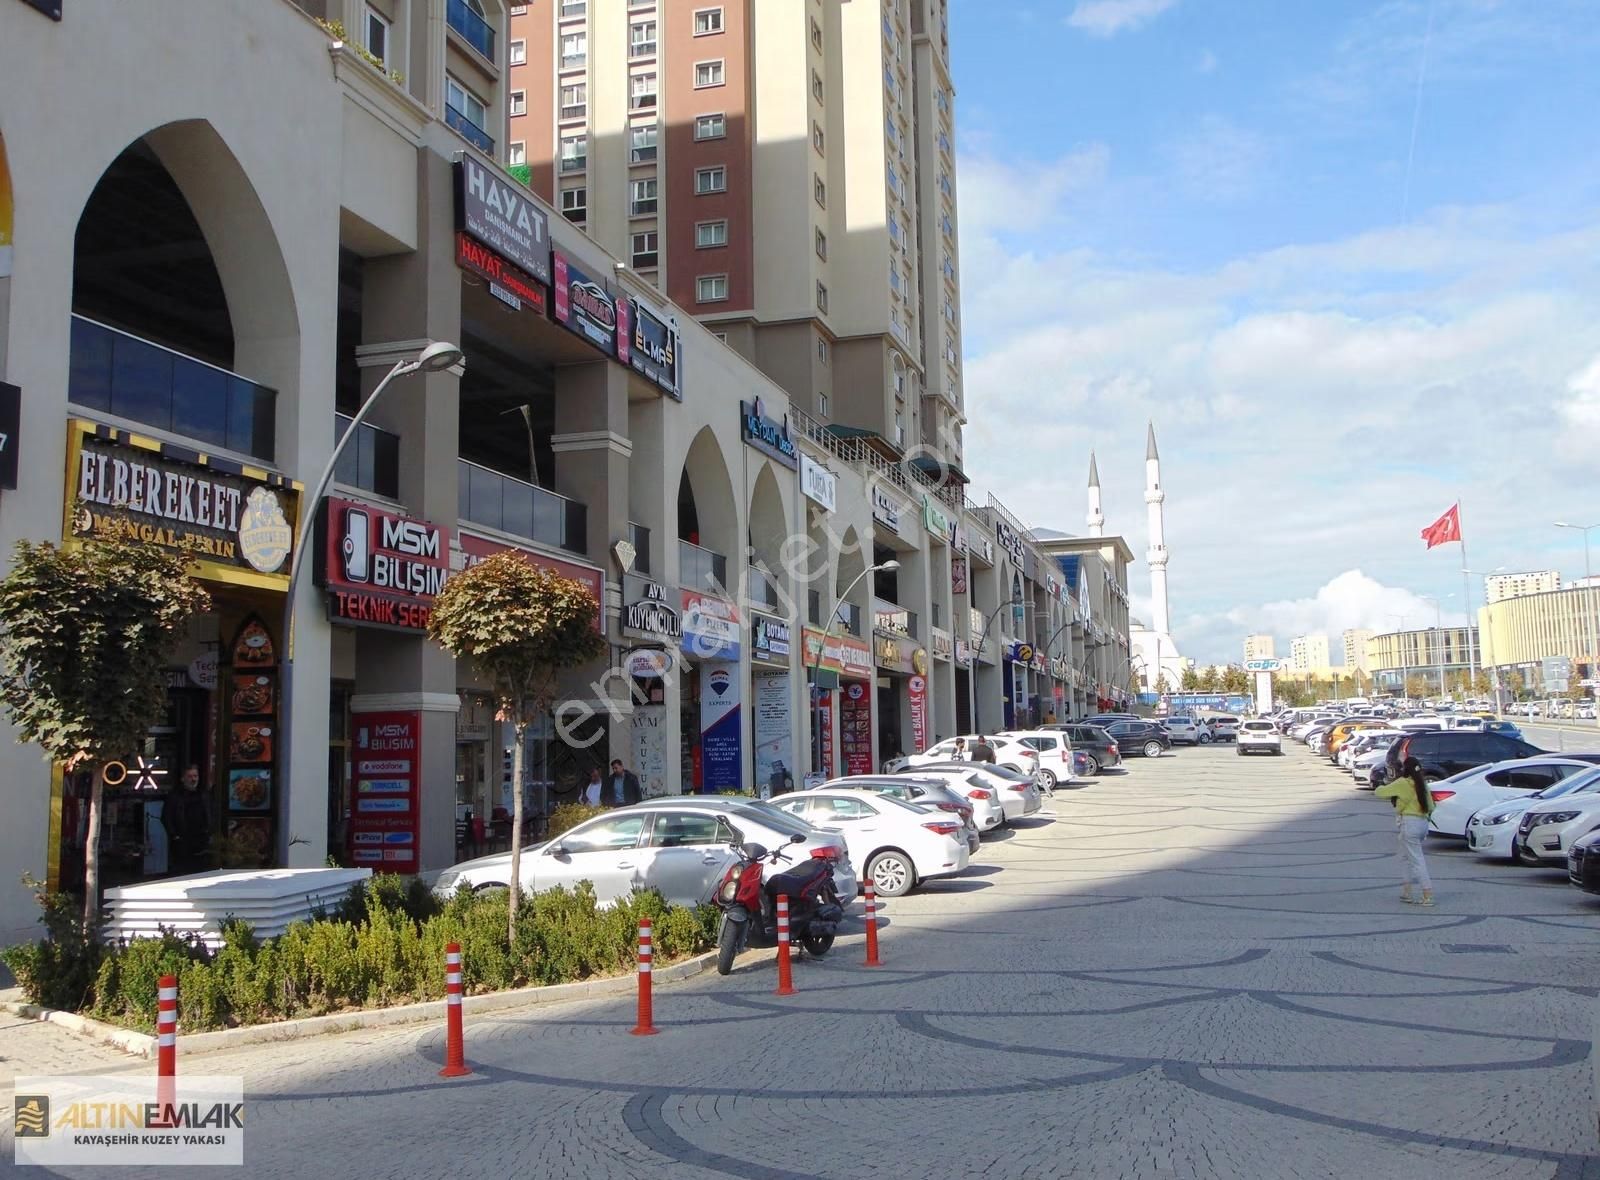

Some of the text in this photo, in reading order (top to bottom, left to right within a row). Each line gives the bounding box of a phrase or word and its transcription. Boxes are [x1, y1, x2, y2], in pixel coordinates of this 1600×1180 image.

[468, 161, 544, 243] HAYAT
[462, 238, 502, 279] HAYAT
[635, 331, 673, 368] ELMAS
[79, 450, 241, 532] ELBEREKEET
[93, 513, 180, 549] MNGAL
[382, 516, 440, 559] MSM
[375, 724, 409, 736] MSM
[371, 762, 403, 770] vodafone
